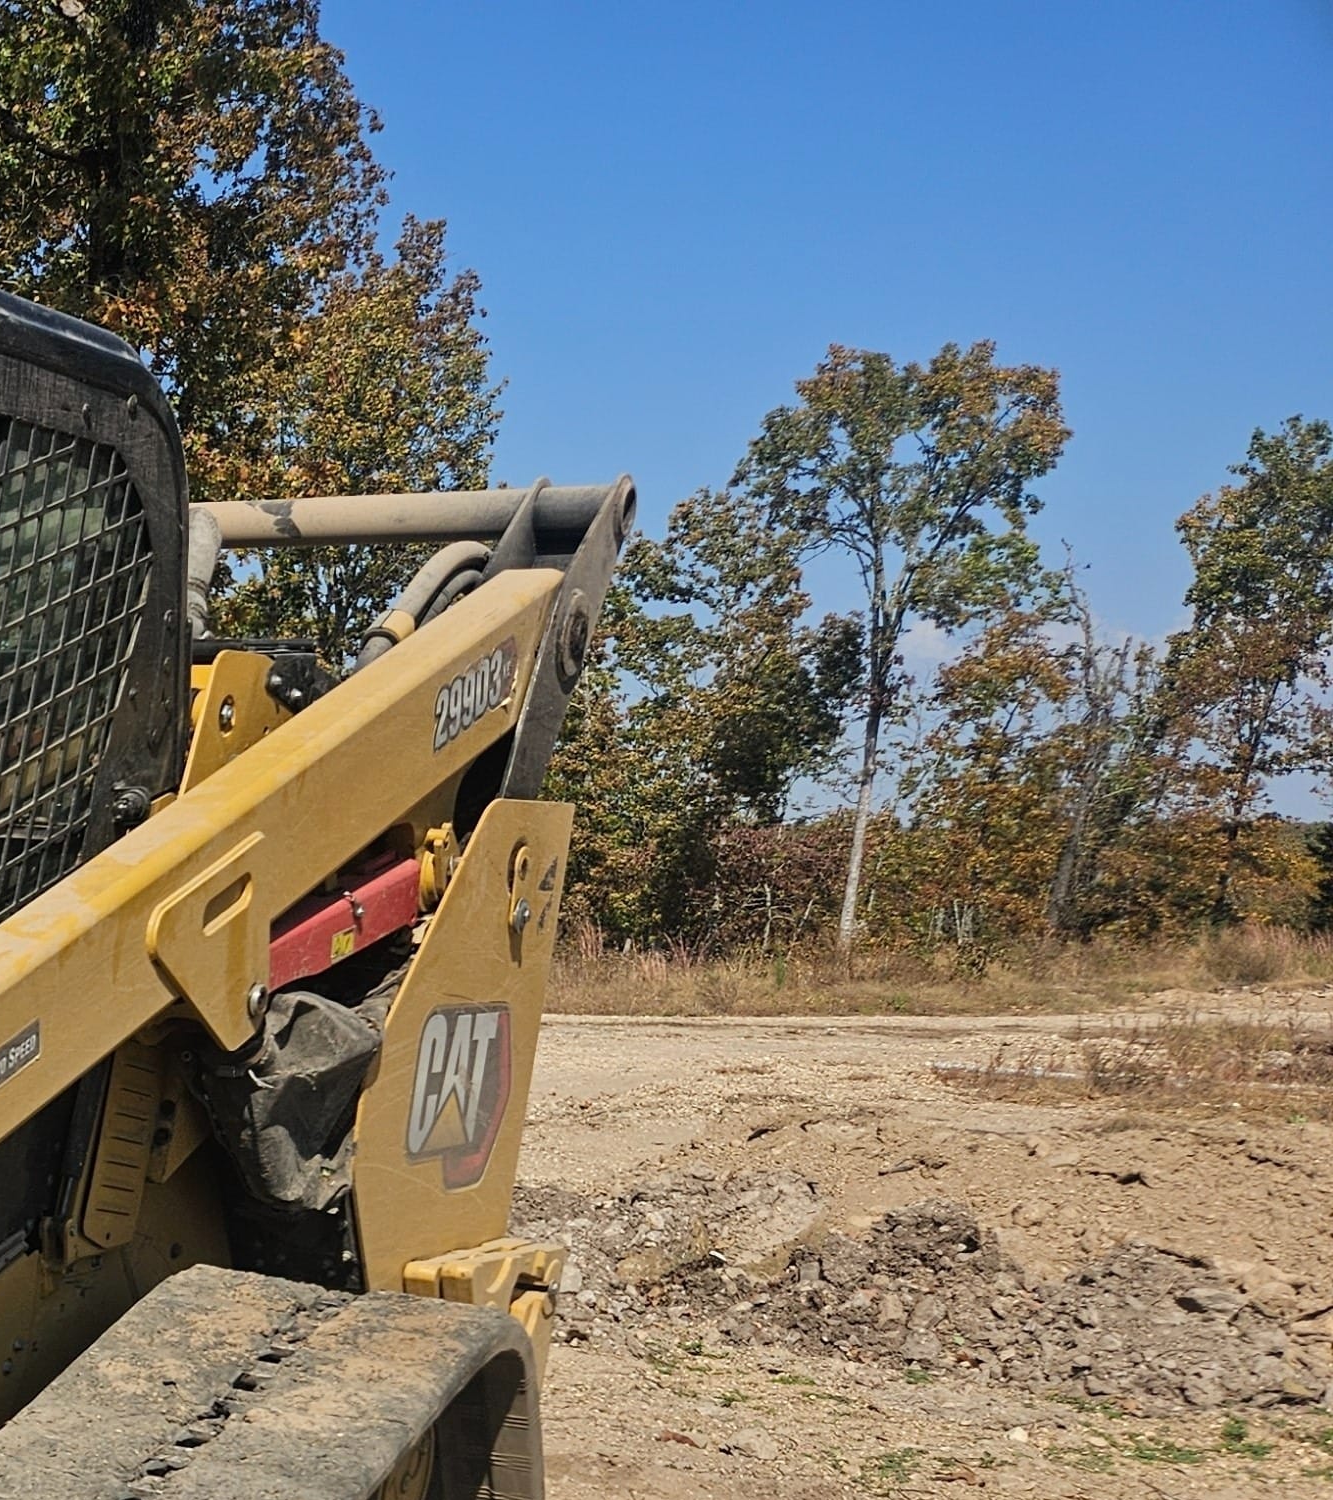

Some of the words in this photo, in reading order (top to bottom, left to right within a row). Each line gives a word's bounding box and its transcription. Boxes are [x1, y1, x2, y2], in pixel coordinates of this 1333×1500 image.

[435, 648, 503, 751] 299D3
[8, 1034, 36, 1069] SPEED
[407, 1010, 501, 1154] CAT
